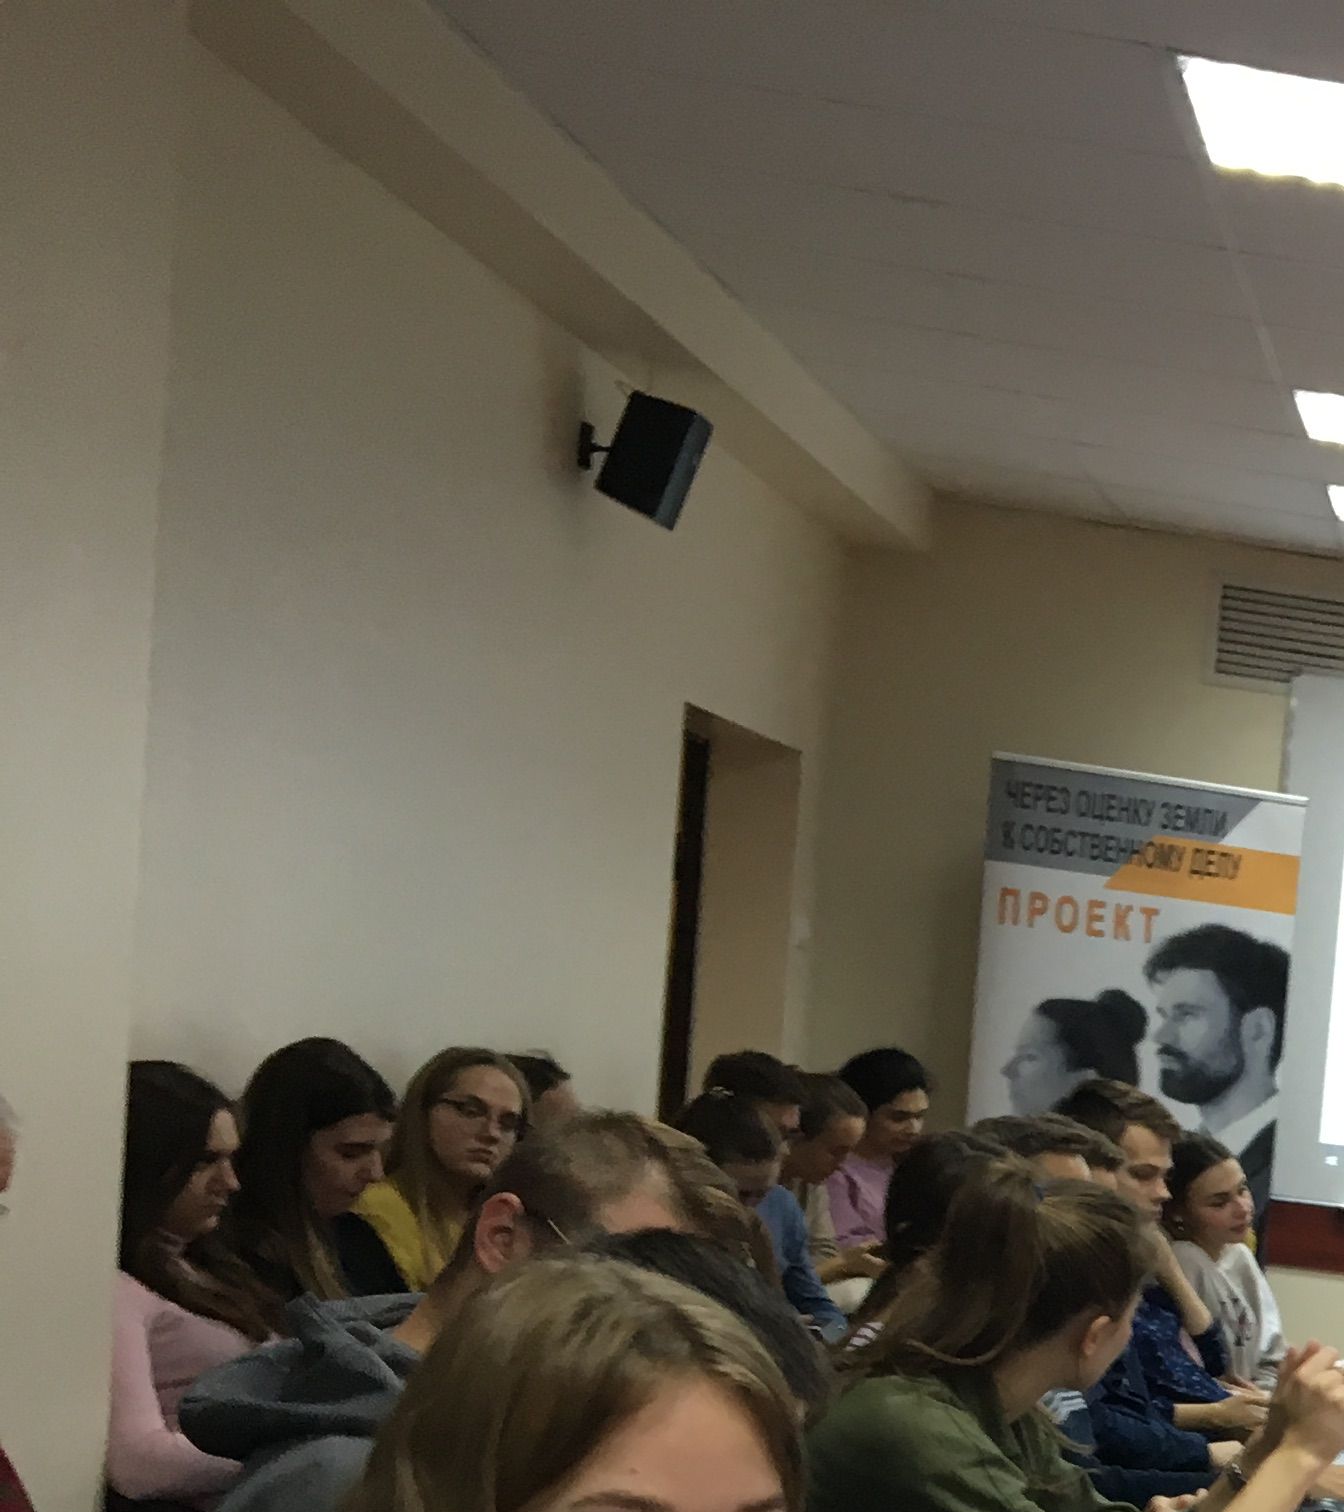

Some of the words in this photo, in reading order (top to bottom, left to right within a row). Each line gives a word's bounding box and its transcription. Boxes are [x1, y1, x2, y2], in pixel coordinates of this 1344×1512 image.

[1006, 780, 1071, 815] ЧЕРЕЗ
[1076, 789, 1155, 827] ОЦЕНКУ
[1019, 822, 1186, 873] СОБСТВЕННОМУ
[998, 886, 1161, 944] ПРОЕКТ
